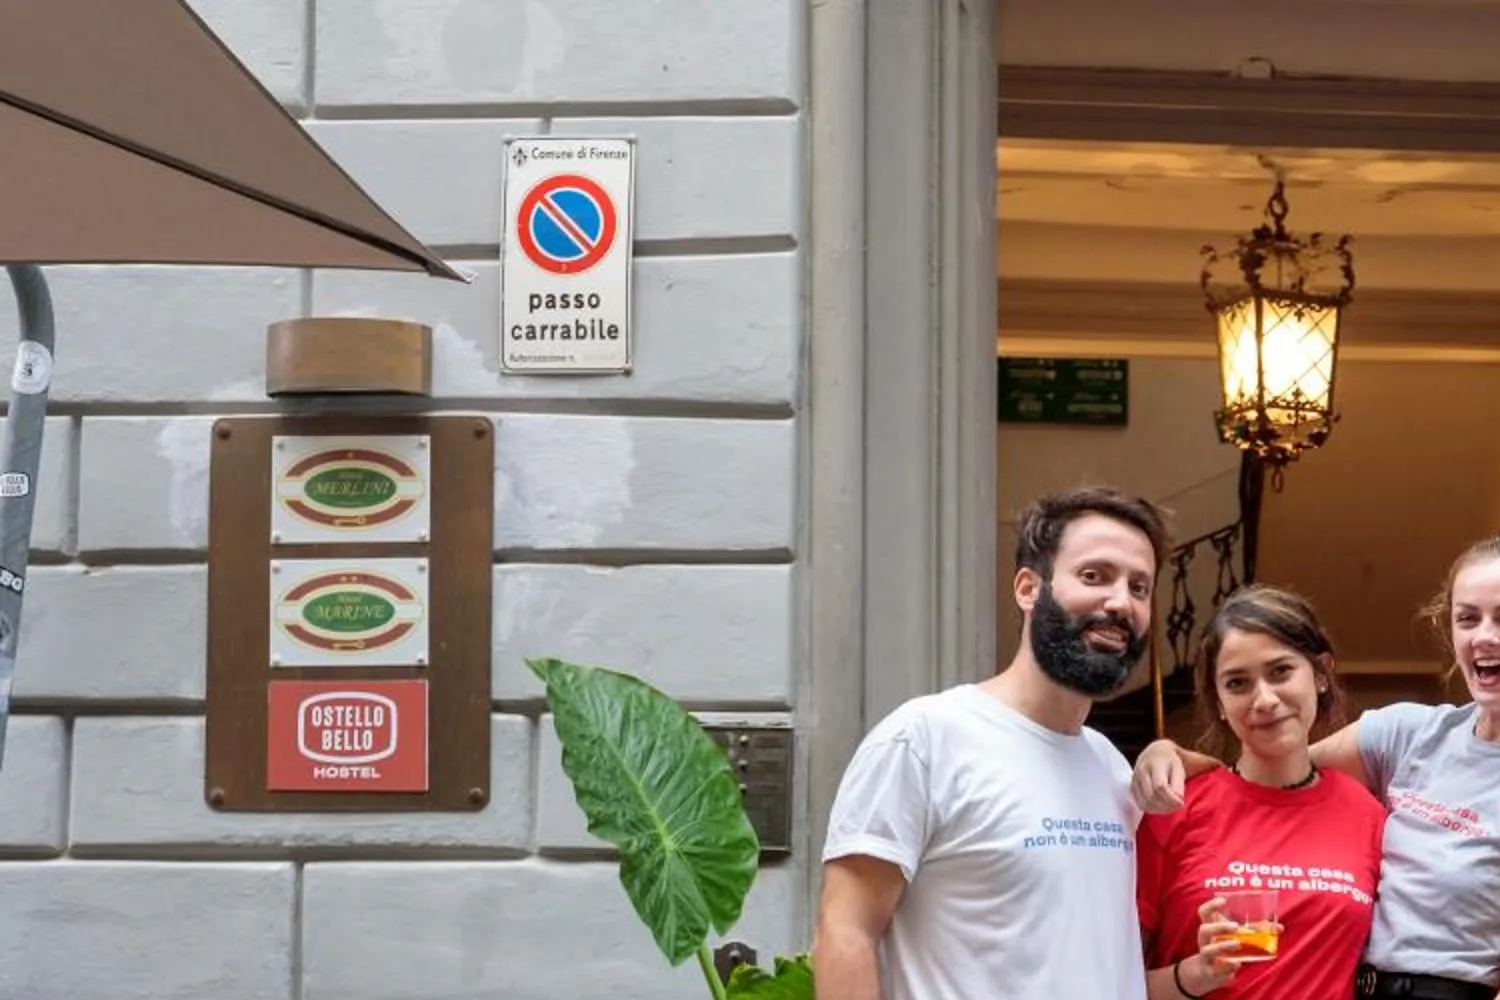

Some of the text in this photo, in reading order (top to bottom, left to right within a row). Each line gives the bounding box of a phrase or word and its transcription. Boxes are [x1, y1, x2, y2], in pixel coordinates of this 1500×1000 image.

[529, 293, 601, 313] passo
[511, 318, 619, 340] carrabile
[312, 705, 383, 727] OSTELLO
[322, 729, 373, 751] BELLO
[313, 767, 381, 779] HOSTEL
[1042, 817, 1091, 832] Questa
[1024, 835, 1056, 848] non
[1205, 876, 1245, 889] non
[1250, 875, 1262, 888] è
[1267, 877, 1293, 889] un
[1228, 861, 1355, 883] Questa casa
